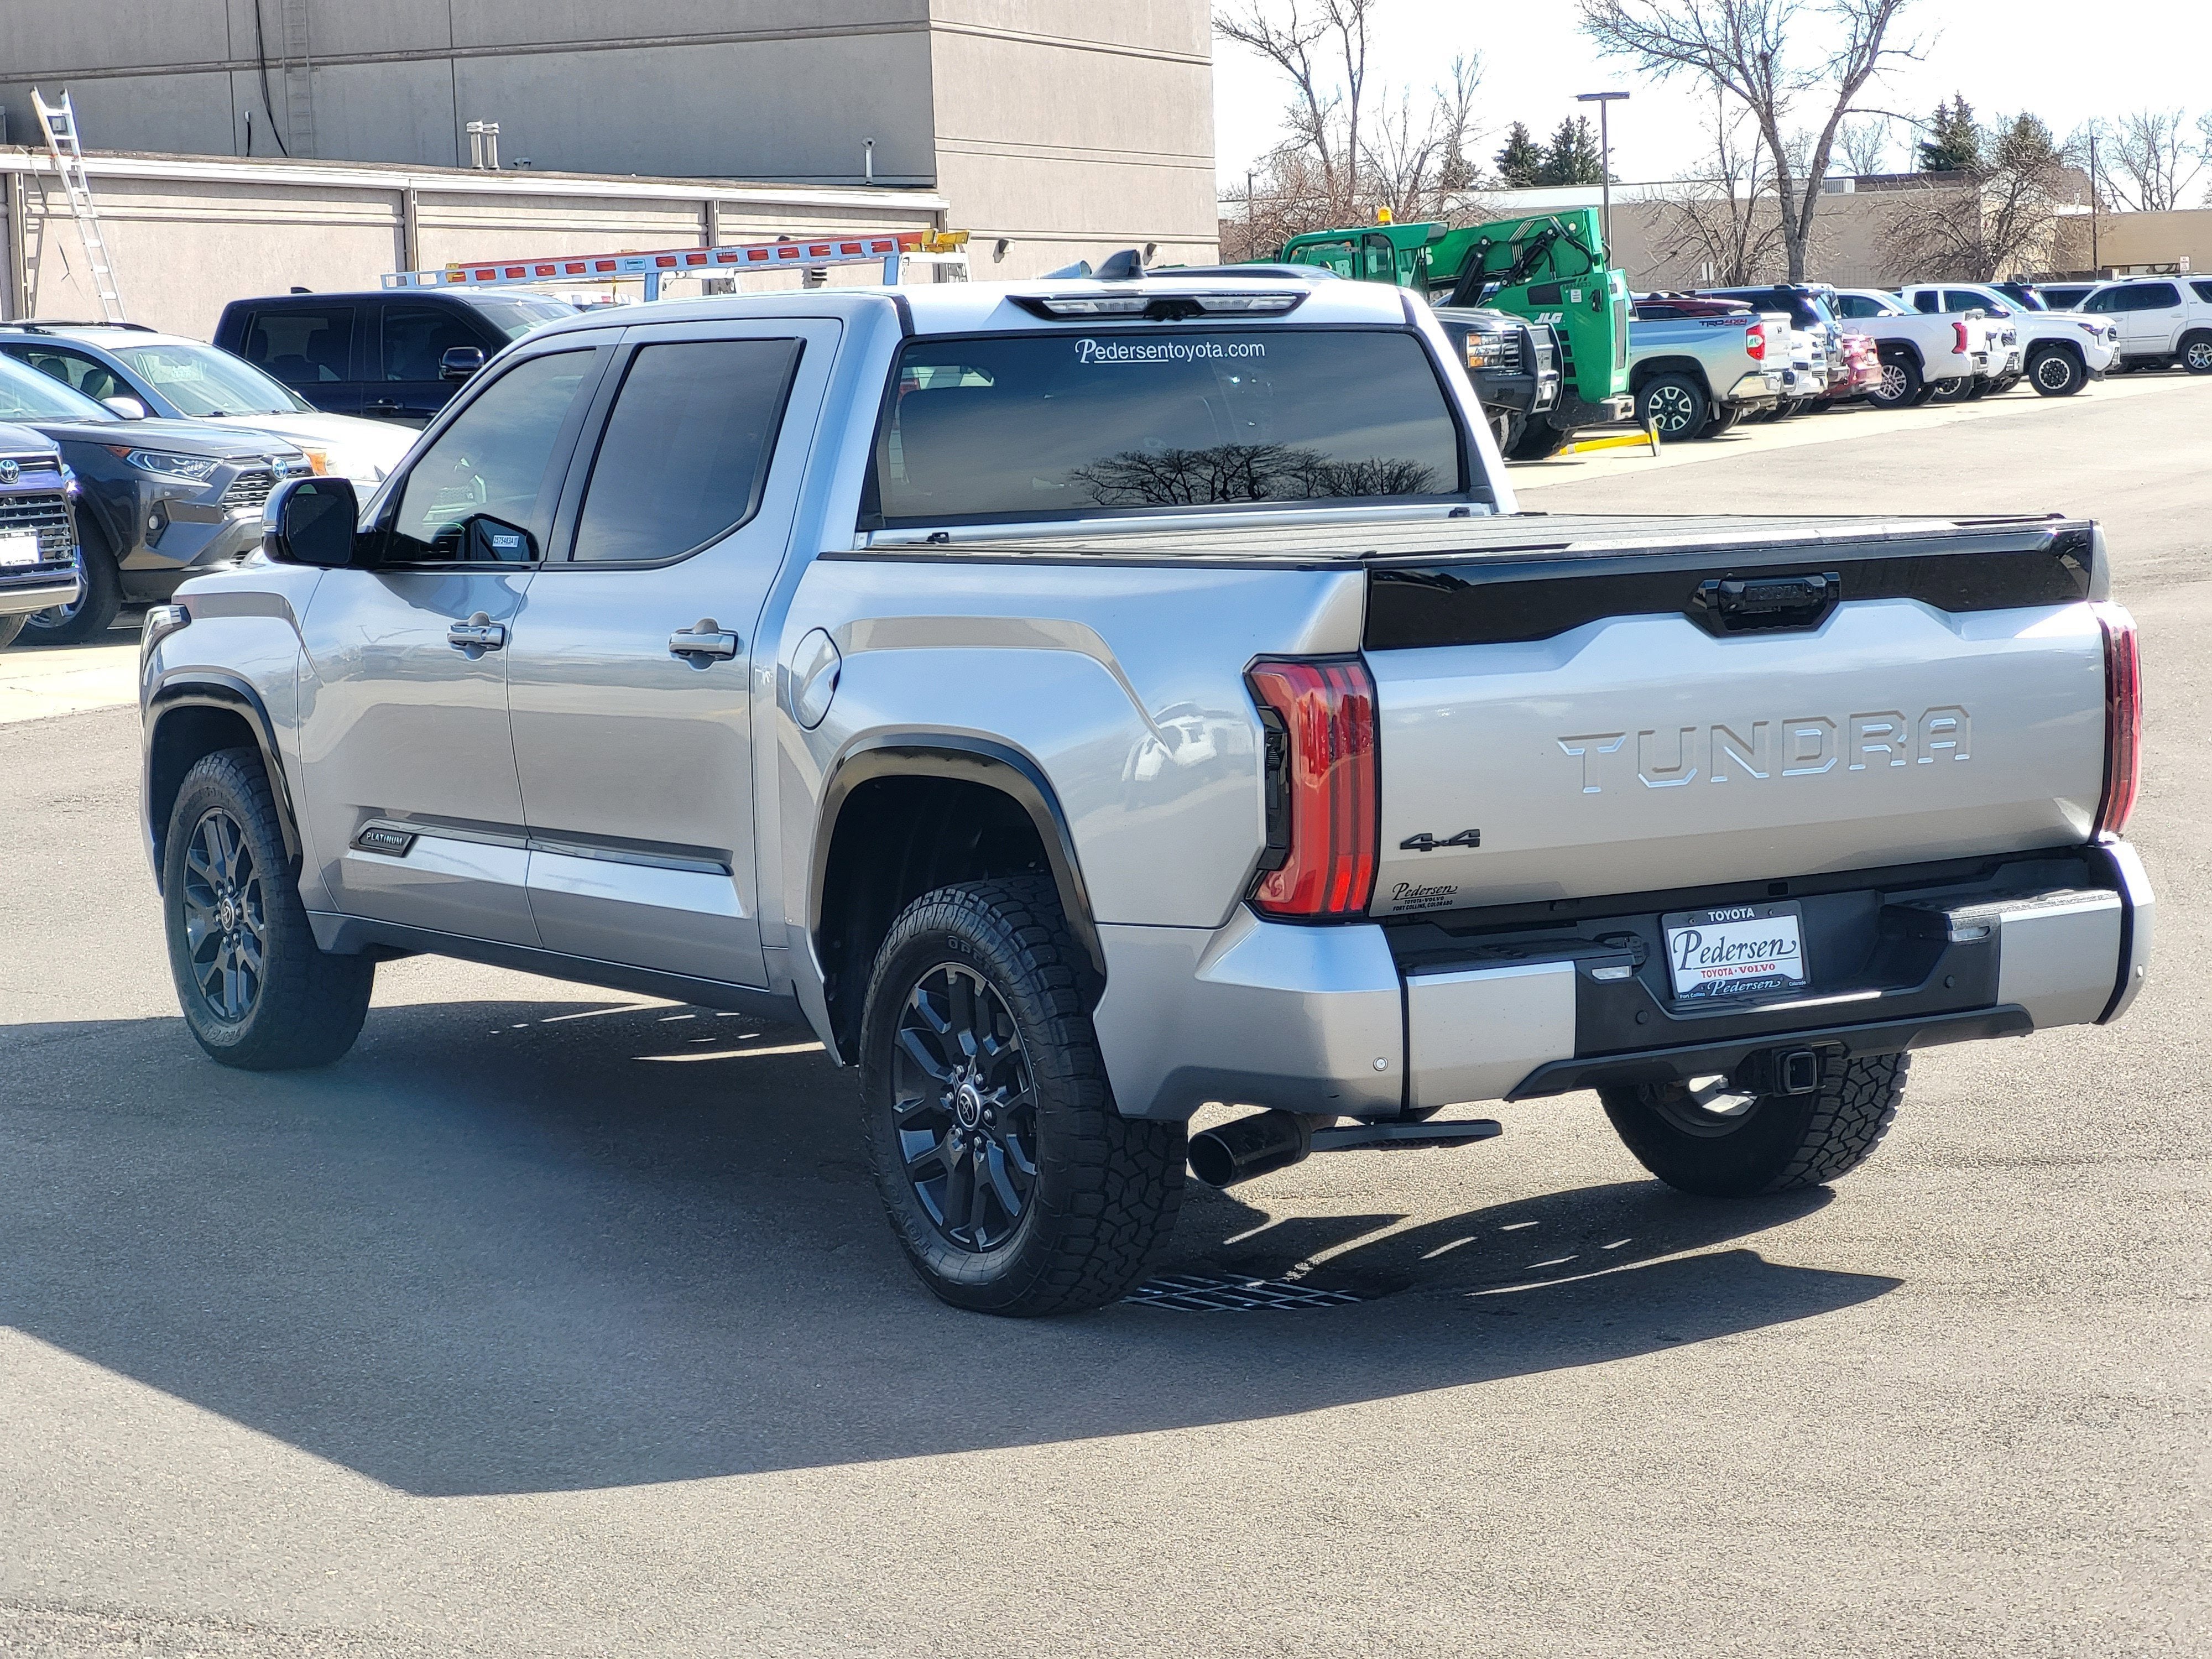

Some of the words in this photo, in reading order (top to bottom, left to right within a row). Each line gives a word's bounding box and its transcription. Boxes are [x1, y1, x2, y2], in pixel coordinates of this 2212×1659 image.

[1534, 312, 1563, 324] JLG
[1075, 338, 1265, 363] Pedersentoyota.com
[1748, 585, 1801, 601] TOYOTA
[1557, 705, 1972, 793] TUNDRA
[366, 832, 403, 845] PLATINUM
[1392, 883, 1458, 901] Pedersen
[1708, 907, 1755, 922] TOYOTA
[1673, 930, 1796, 971] Pedersen
[1701, 969, 1733, 978] TOYOTA
[1738, 963, 1775, 973] VOLVO
[1707, 979, 1781, 996] Pedersen
